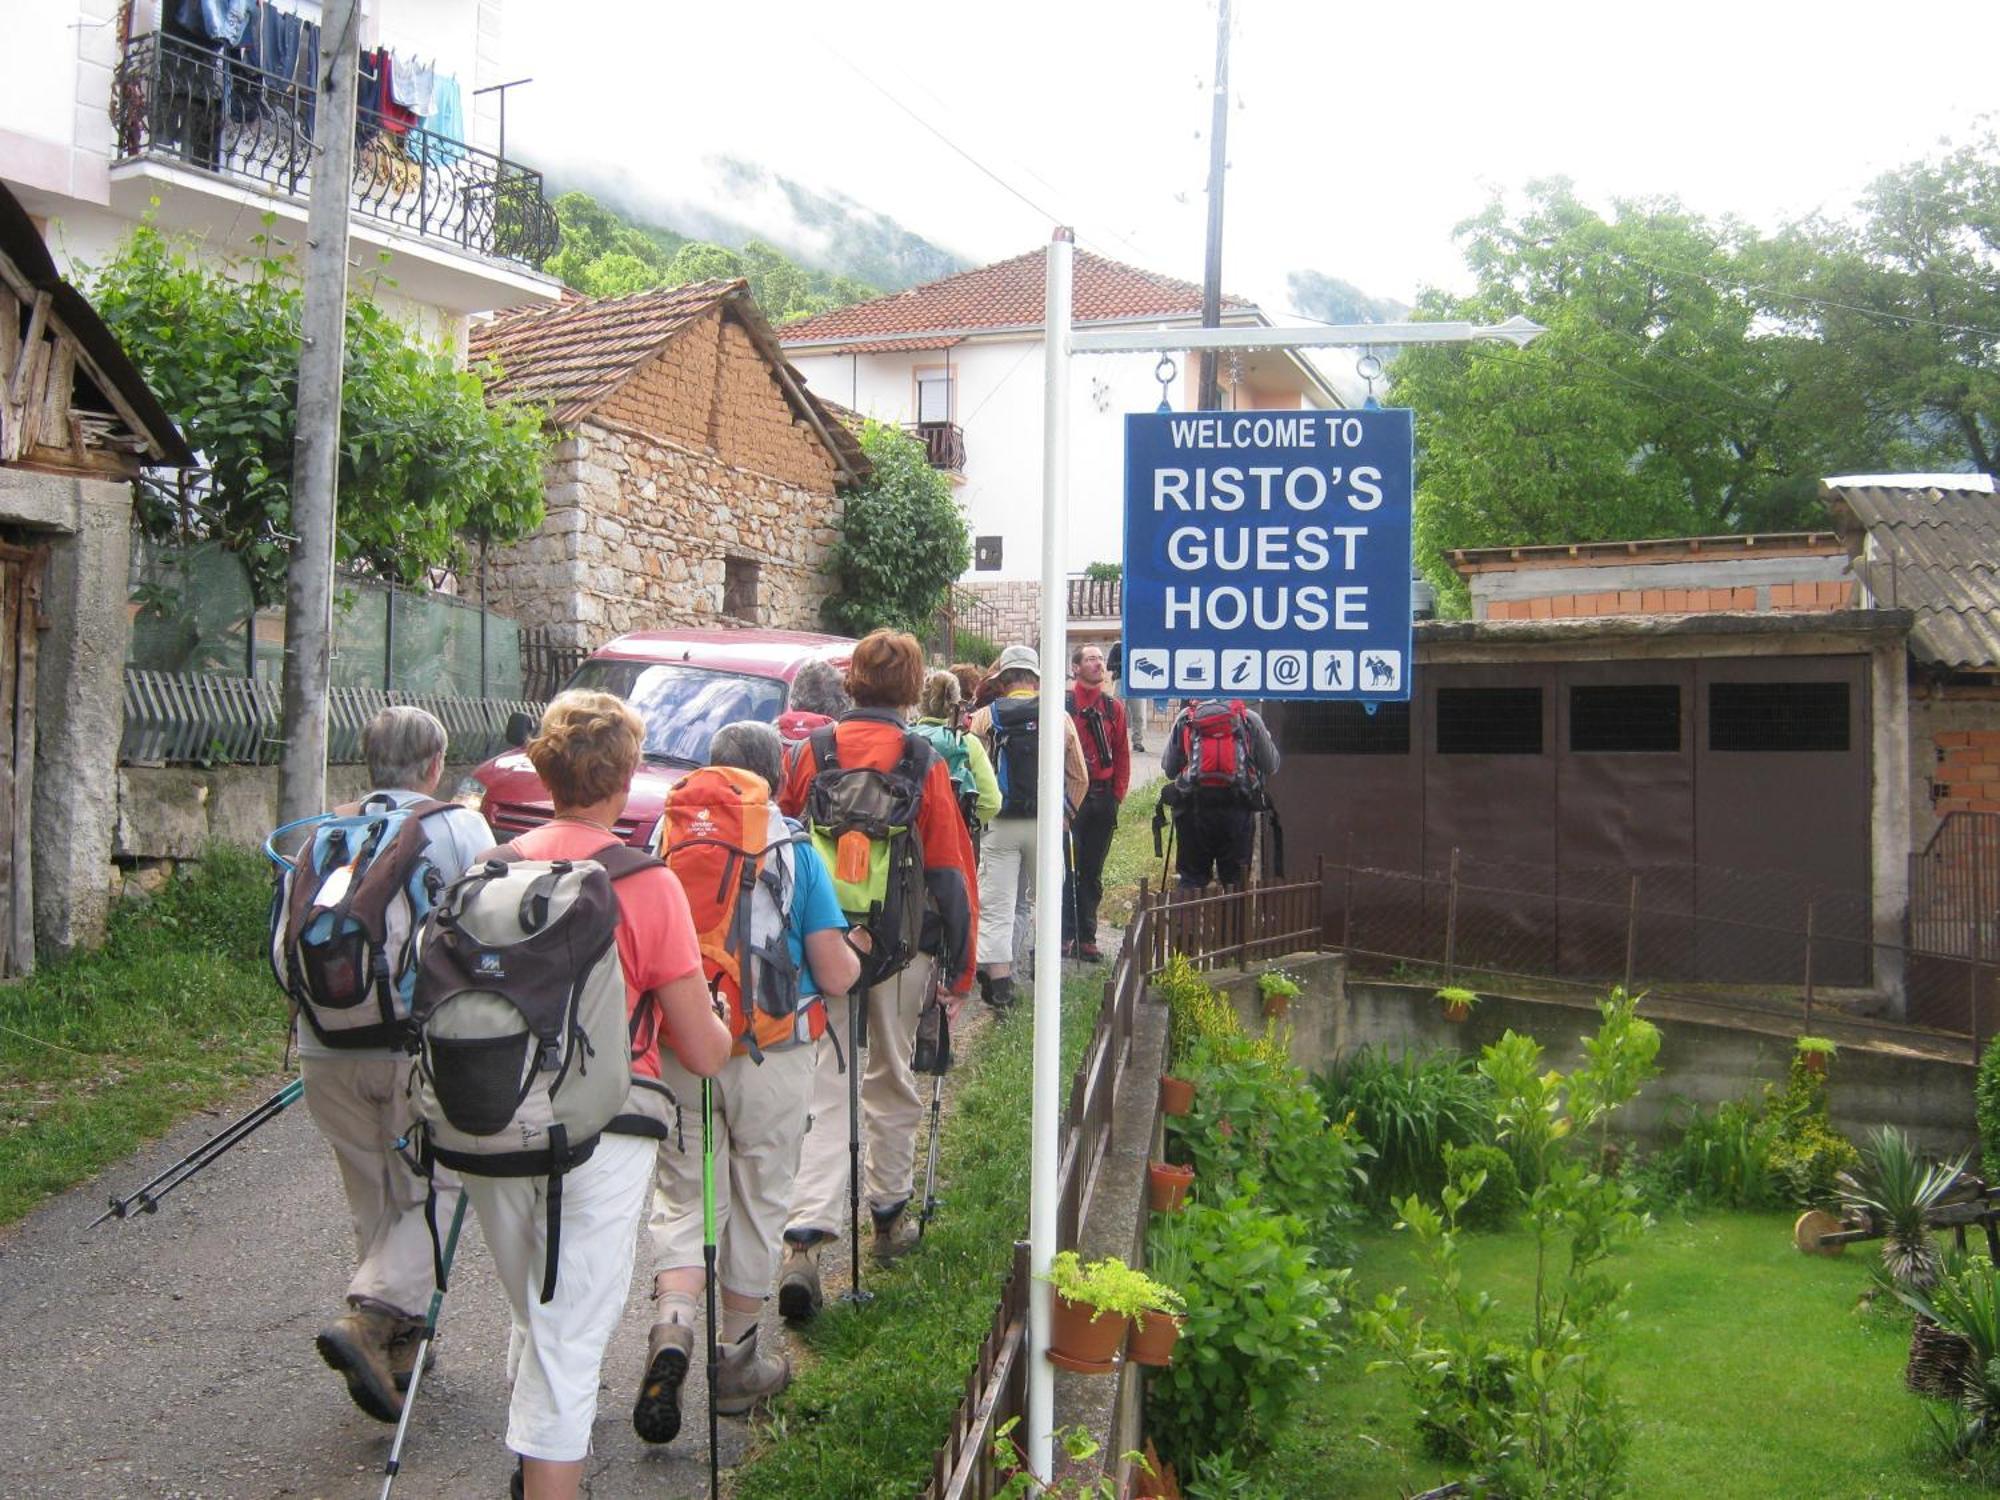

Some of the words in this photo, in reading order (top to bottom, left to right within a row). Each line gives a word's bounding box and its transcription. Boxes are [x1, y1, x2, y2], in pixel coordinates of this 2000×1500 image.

[1171, 419, 1316, 449] WELCOME
[1324, 418, 1363, 448] TO
[1153, 467, 1383, 512] RISTO'S
[1167, 526, 1369, 571] GUEST
[1165, 586, 1370, 631] HOUSE
